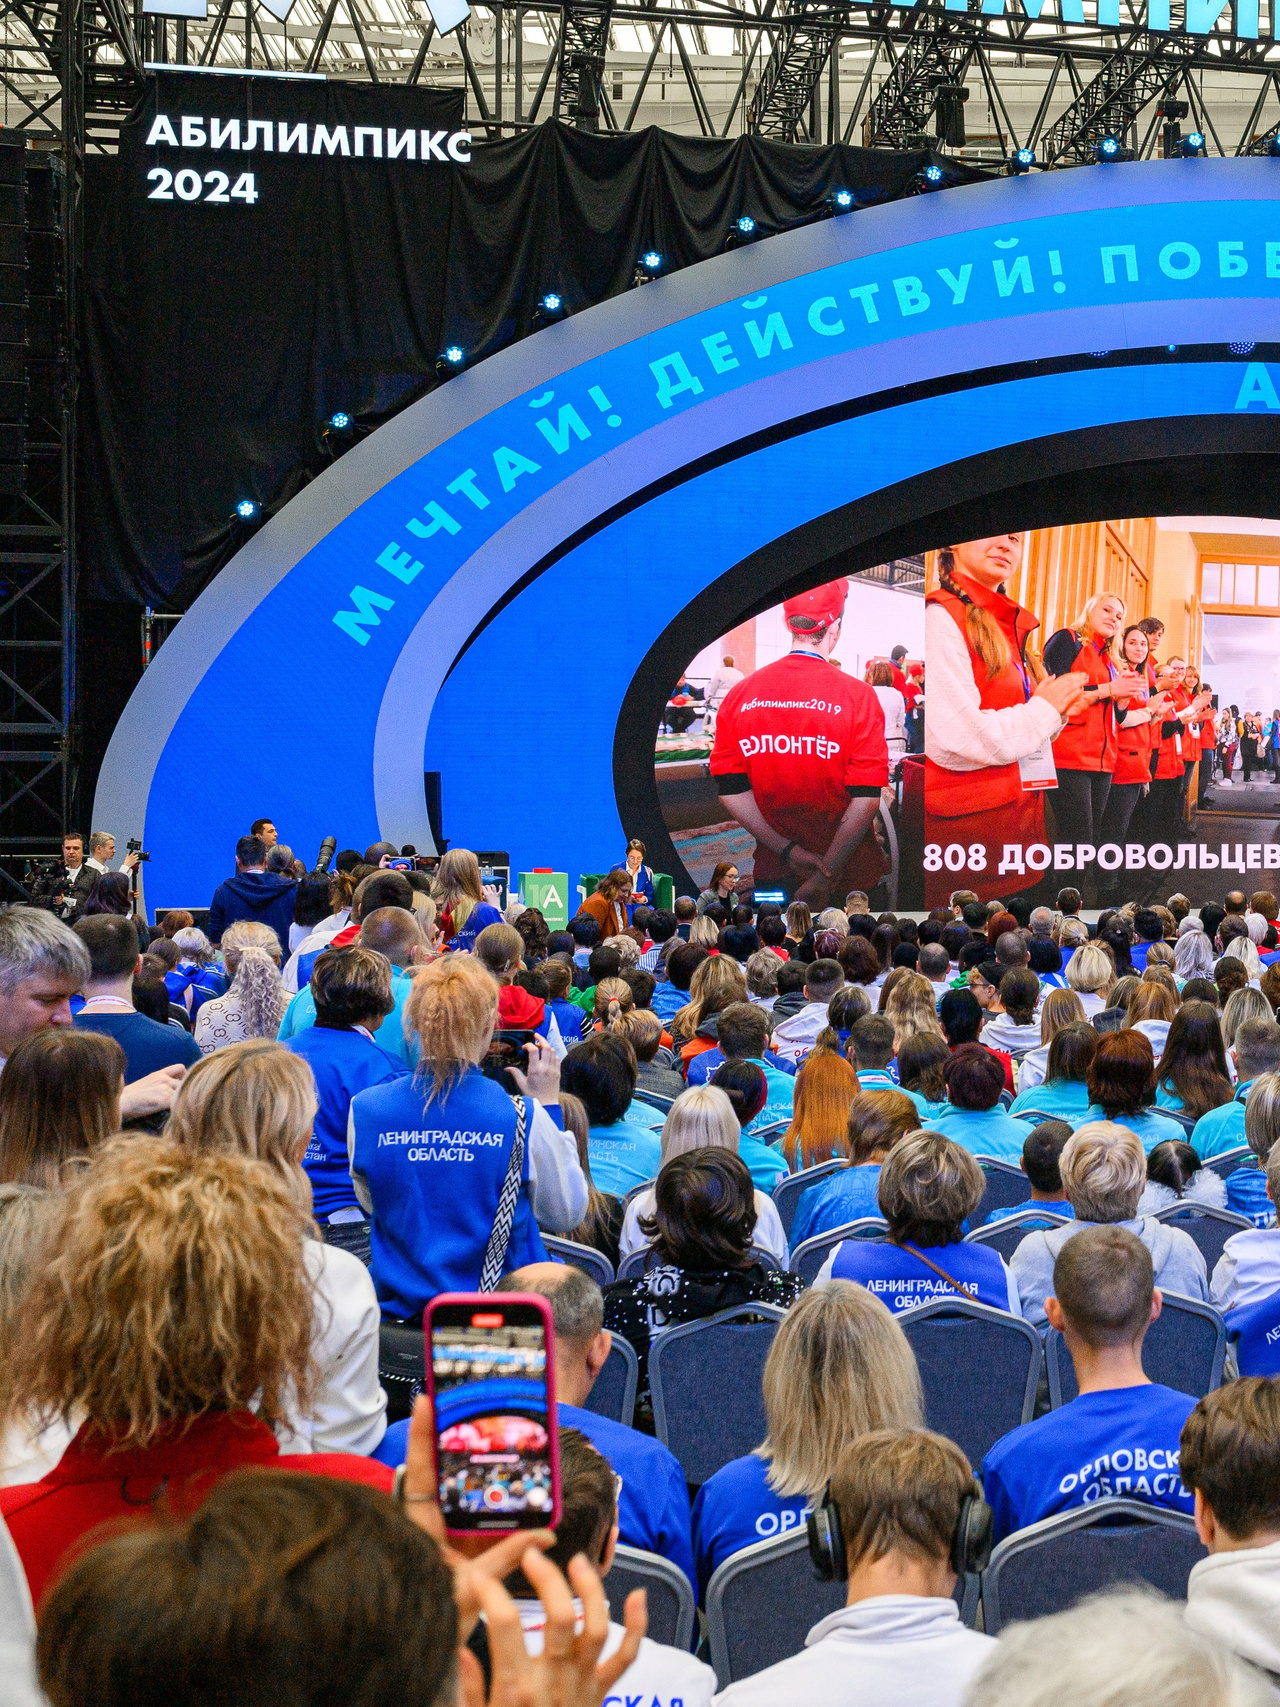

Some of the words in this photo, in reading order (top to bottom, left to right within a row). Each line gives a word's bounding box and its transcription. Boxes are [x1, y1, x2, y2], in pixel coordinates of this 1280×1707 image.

[145, 114, 472, 163] АБИЛИМПИКС
[147, 167, 258, 204] 2024
[332, 385, 622, 646] МЕЧТАЙ!
[648, 236, 1067, 409] ДЕЙСТВУЙ!
[738, 734, 840, 760] ВОЛОНТЁР
[923, 843, 987, 872] 808
[377, 1130, 504, 1149] ЛЕНИНГРАДСКАЯ
[407, 1146, 475, 1162] ОБЛАСТЬ
[1059, 1448, 1181, 1494] ОРЛОВСК
